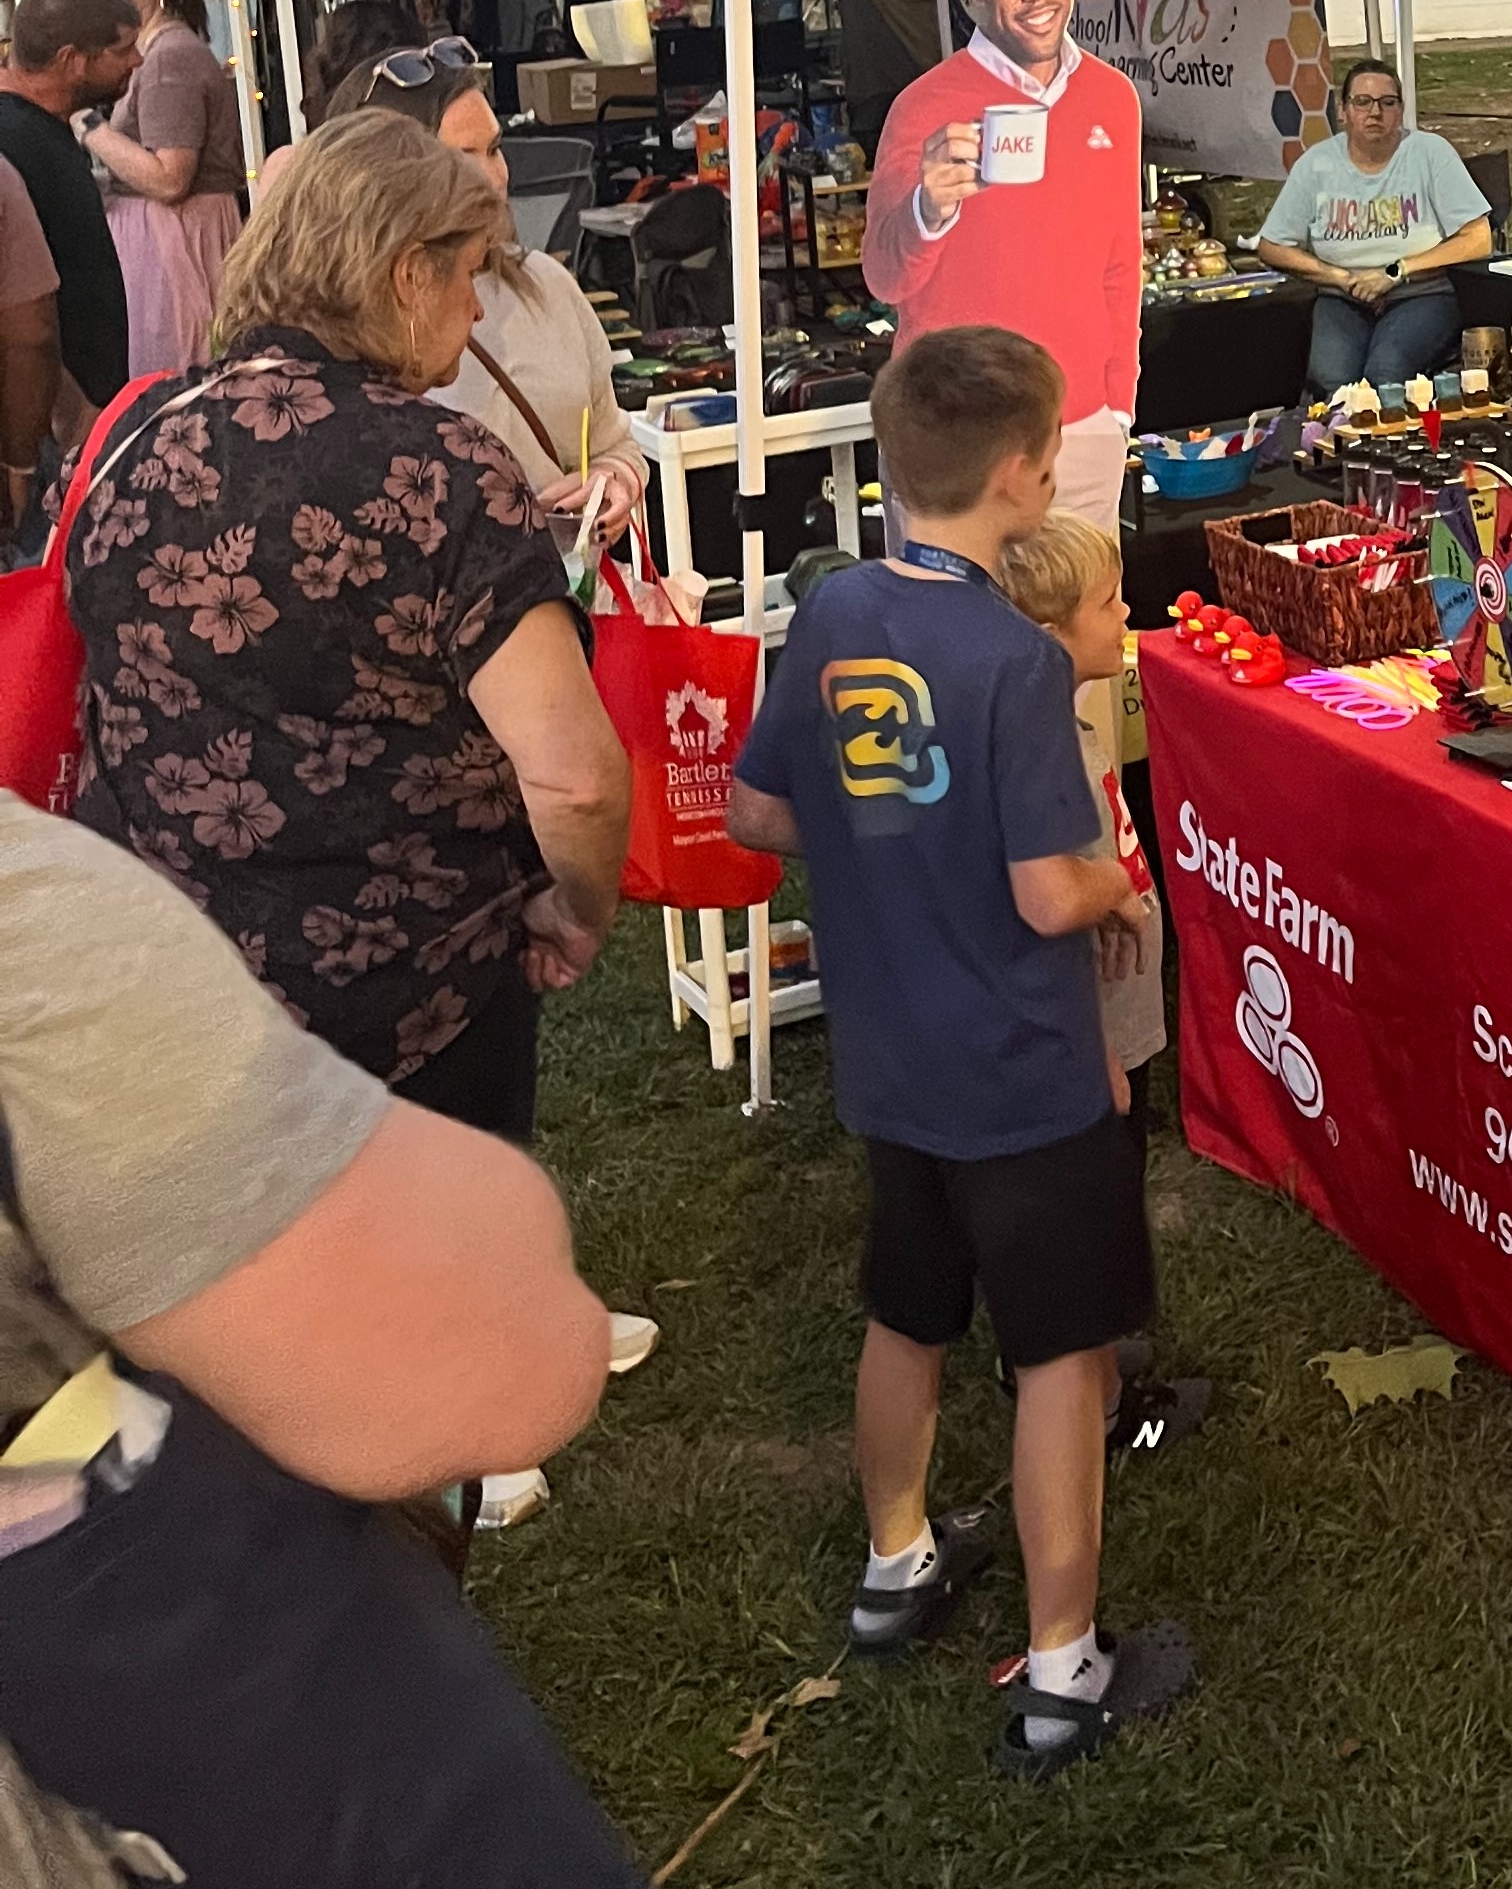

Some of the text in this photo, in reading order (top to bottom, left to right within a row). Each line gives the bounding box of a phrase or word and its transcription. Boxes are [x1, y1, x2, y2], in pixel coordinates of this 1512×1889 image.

[1159, 46, 1234, 88] Center
[991, 136, 1035, 154] JAKE
[665, 760, 732, 787] Bartlet
[666, 787, 732, 808] TENNESS
